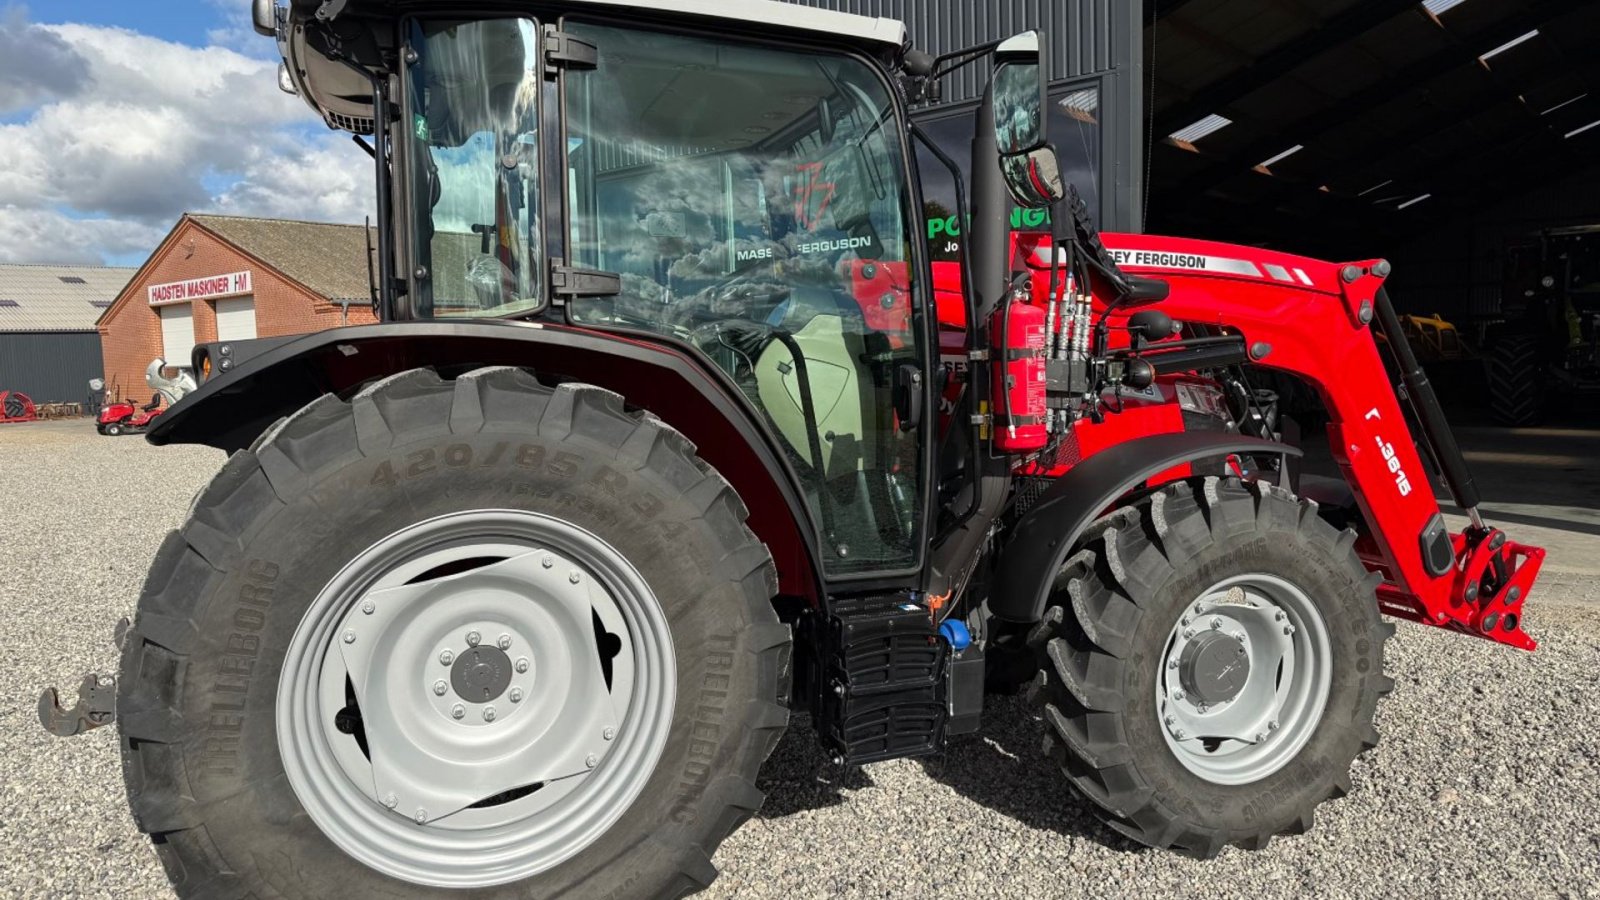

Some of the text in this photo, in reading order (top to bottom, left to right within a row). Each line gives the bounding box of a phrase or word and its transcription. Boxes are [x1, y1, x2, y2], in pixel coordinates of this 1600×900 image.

[1135, 252, 1206, 269] FERGUSON
[151, 283, 186, 302] HADSTEN
[187, 276, 229, 297] MASKINER
